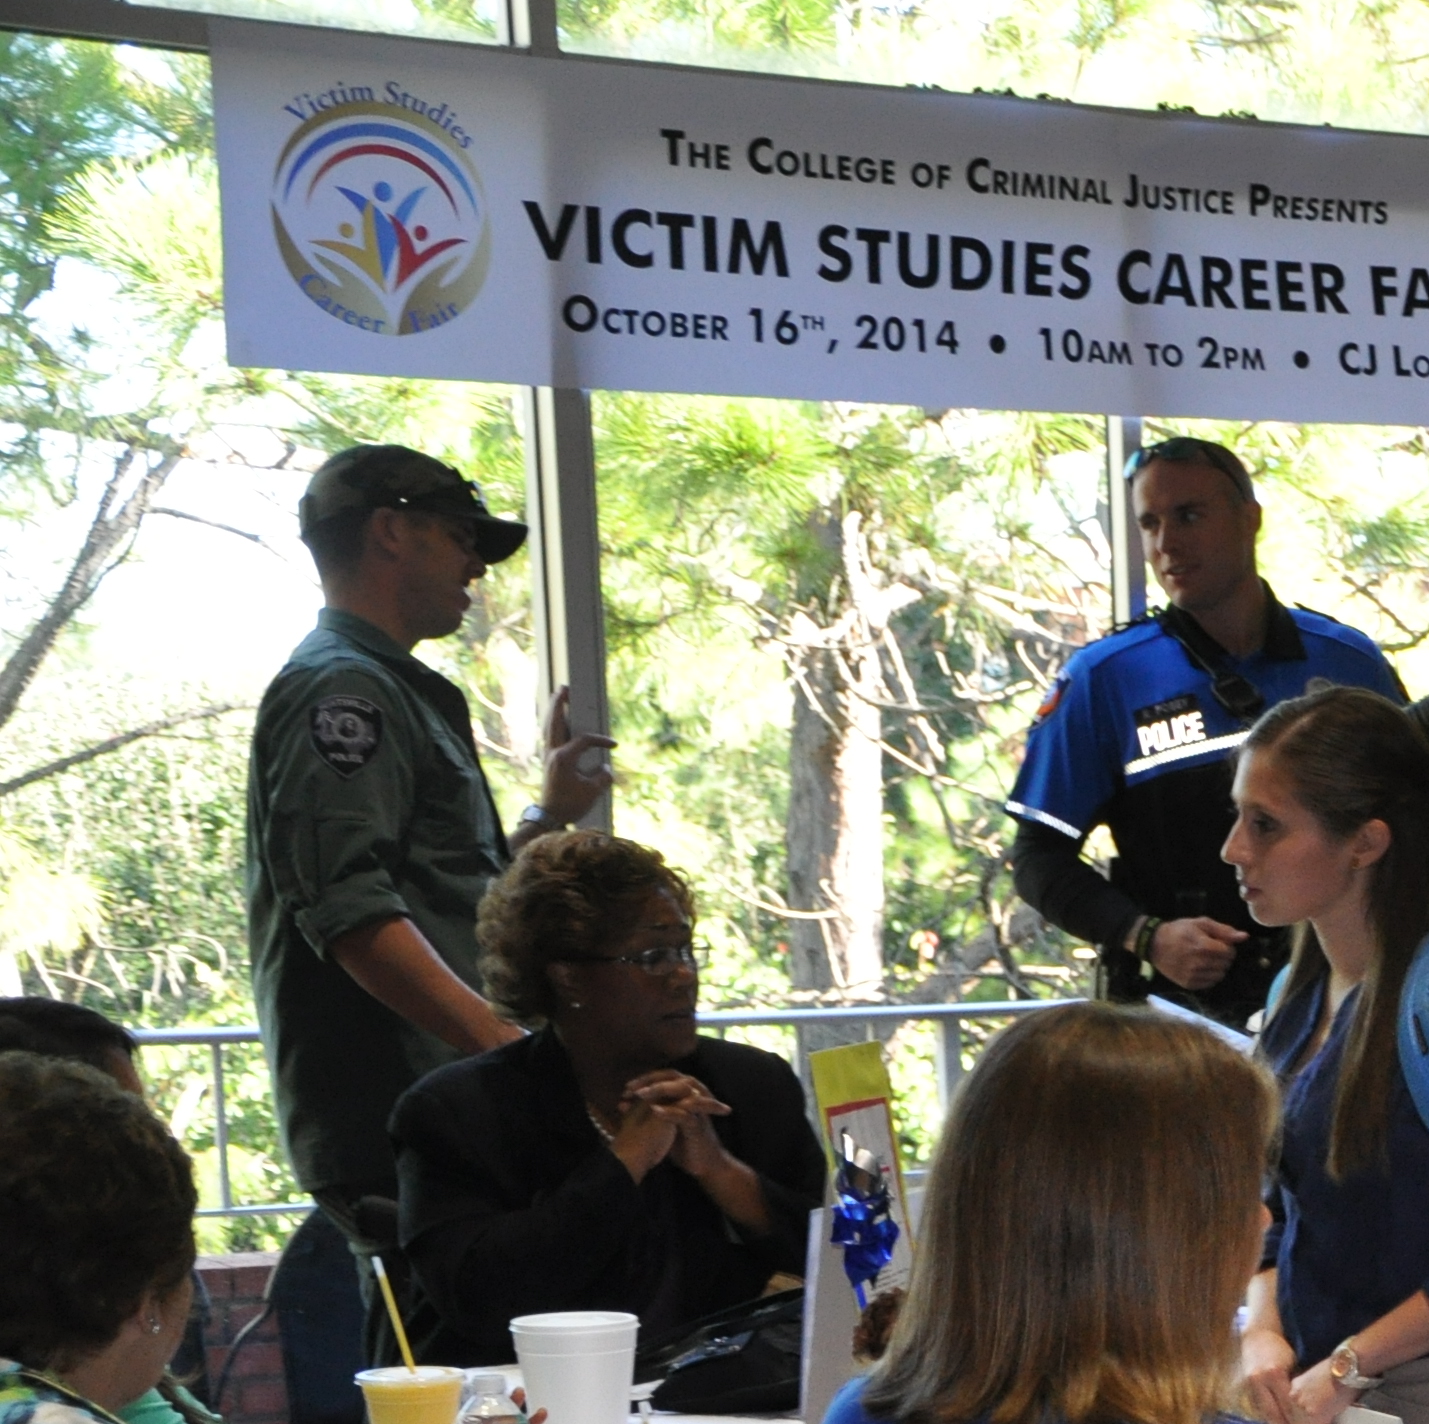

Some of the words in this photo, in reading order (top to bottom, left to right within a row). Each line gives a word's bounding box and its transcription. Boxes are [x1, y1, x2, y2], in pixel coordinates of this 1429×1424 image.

[284, 81, 374, 122] Victim
[384, 81, 473, 149] Studies
[661, 129, 731, 171] THE
[747, 137, 896, 185] COLLEGE
[911, 161, 952, 189] OF
[966, 157, 1113, 204] CRIMINAL
[1124, 174, 1234, 215] JUSTICE
[1249, 184, 1389, 225] PRESENTS
[522, 200, 790, 278] VICTIM
[818, 224, 1092, 300] STUDIES
[1116, 249, 1350, 315] CAREER
[300, 273, 386, 334] Career
[408, 302, 458, 333] Fair
[562, 294, 729, 341] OCTOBER
[855, 314, 959, 355] 2014
[1038, 327, 1133, 366] 10AM
[1144, 342, 1183, 367] TO
[1197, 336, 1266, 371] 2PM
[1339, 342, 1377, 377] CJ
[1137, 711, 1206, 756] POLICE
